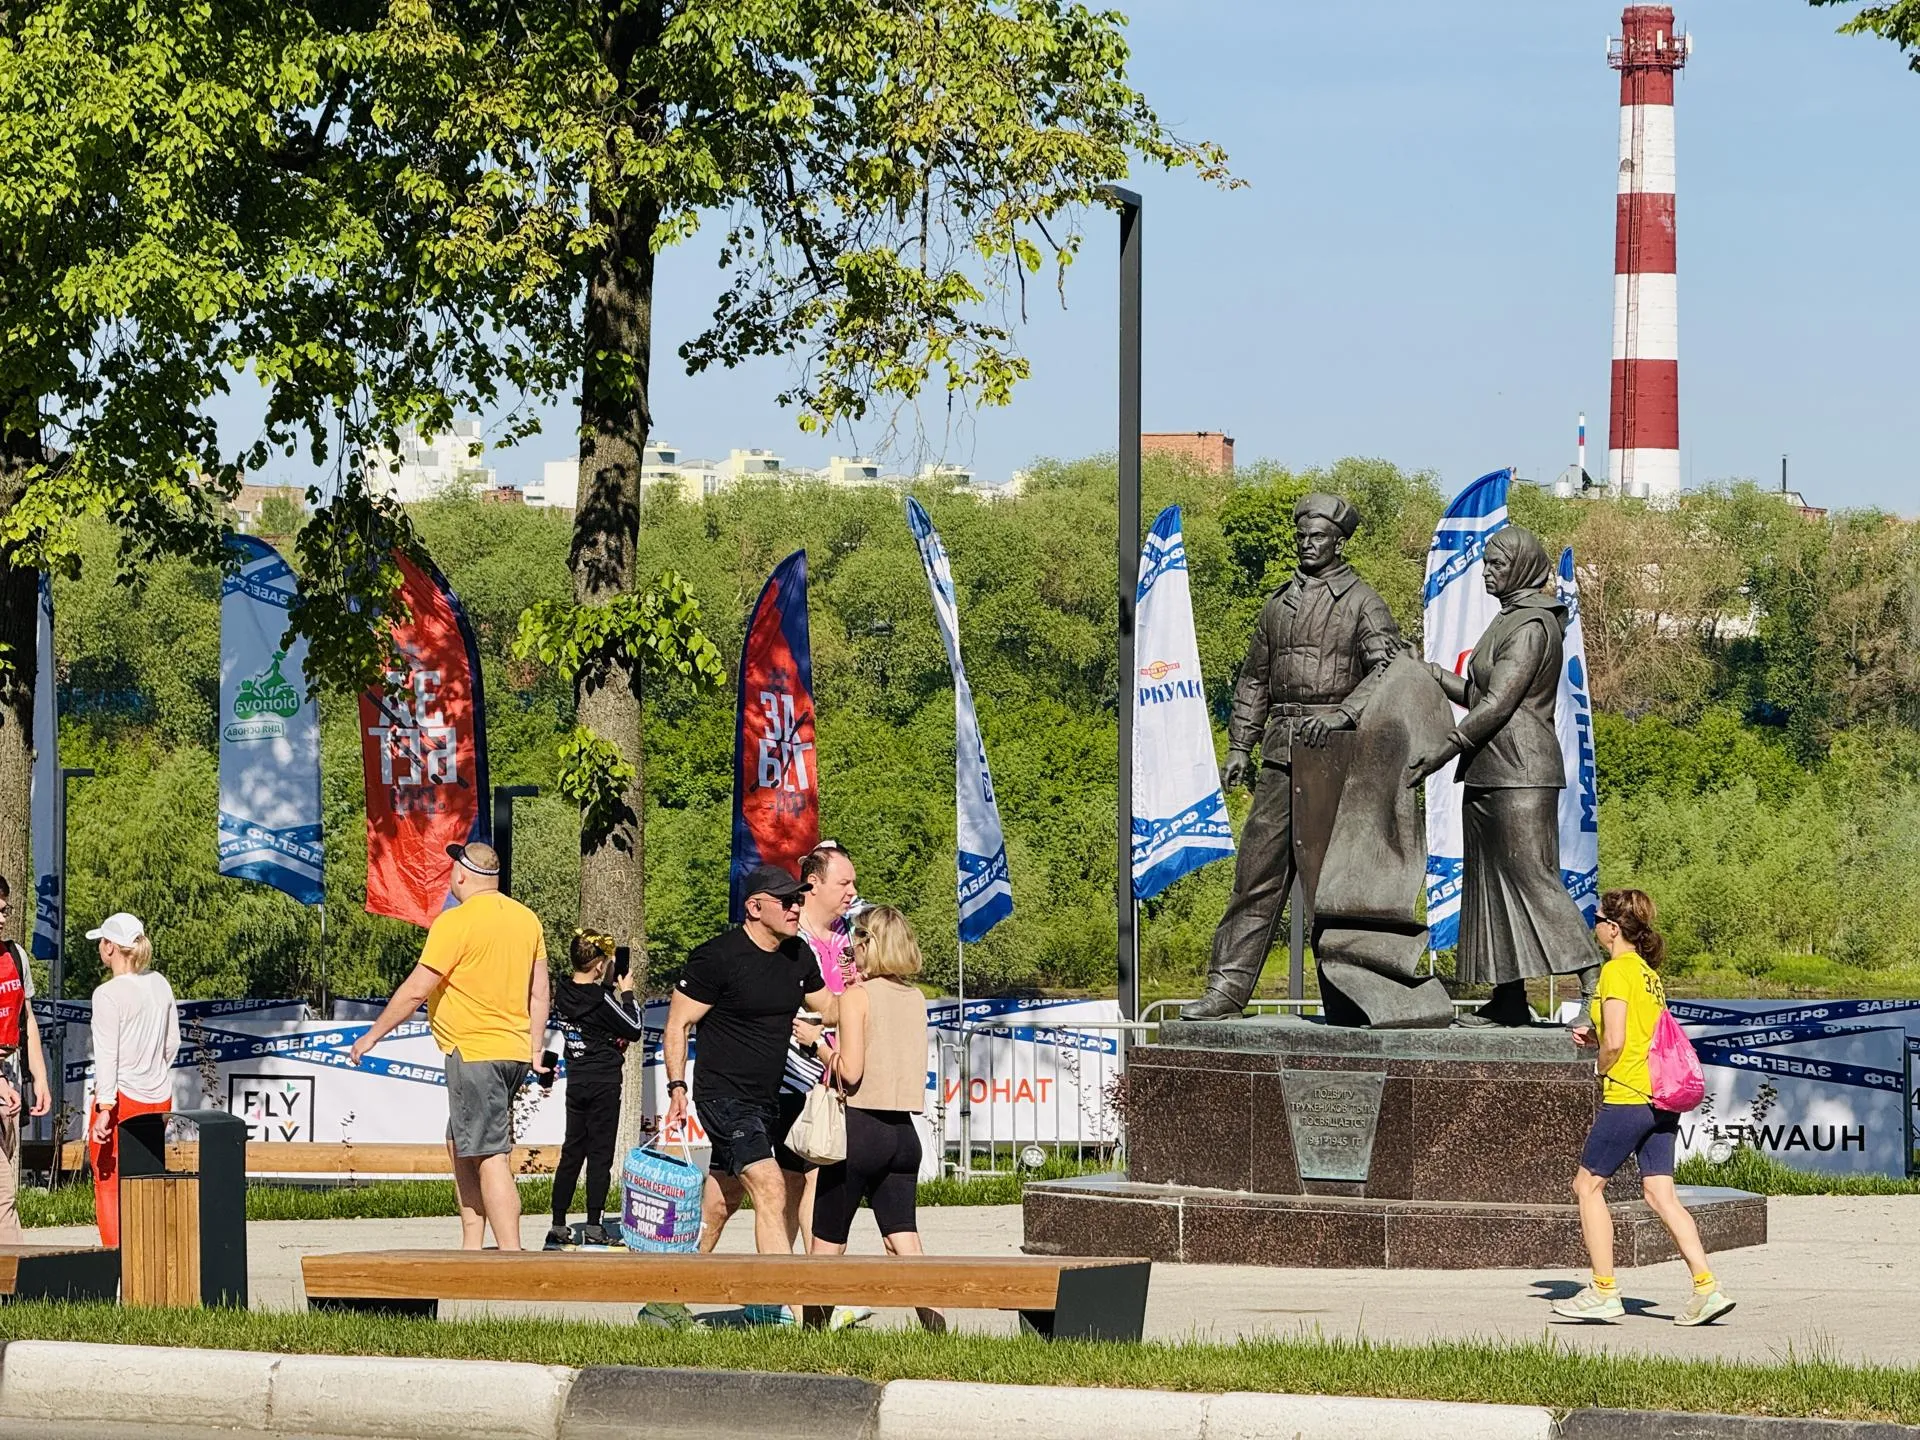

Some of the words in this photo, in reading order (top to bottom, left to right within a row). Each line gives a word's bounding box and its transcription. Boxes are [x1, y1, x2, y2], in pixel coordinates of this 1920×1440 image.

[1740, 1008, 1829, 1027] ЗАБЕГ.РФ
[251, 1033, 344, 1054] ЗАБЕГ.РФ
[1314, 1088, 1355, 1099] ПОДВИГУ
[244, 1090, 301, 1117] FLY
[1290, 1101, 1348, 1113] ТРУЖЕНИКОВ
[1350, 1105, 1377, 1114] ТЫЛА
[1302, 1116, 1366, 1128] ПОСВЯЩАЕТСЯ
